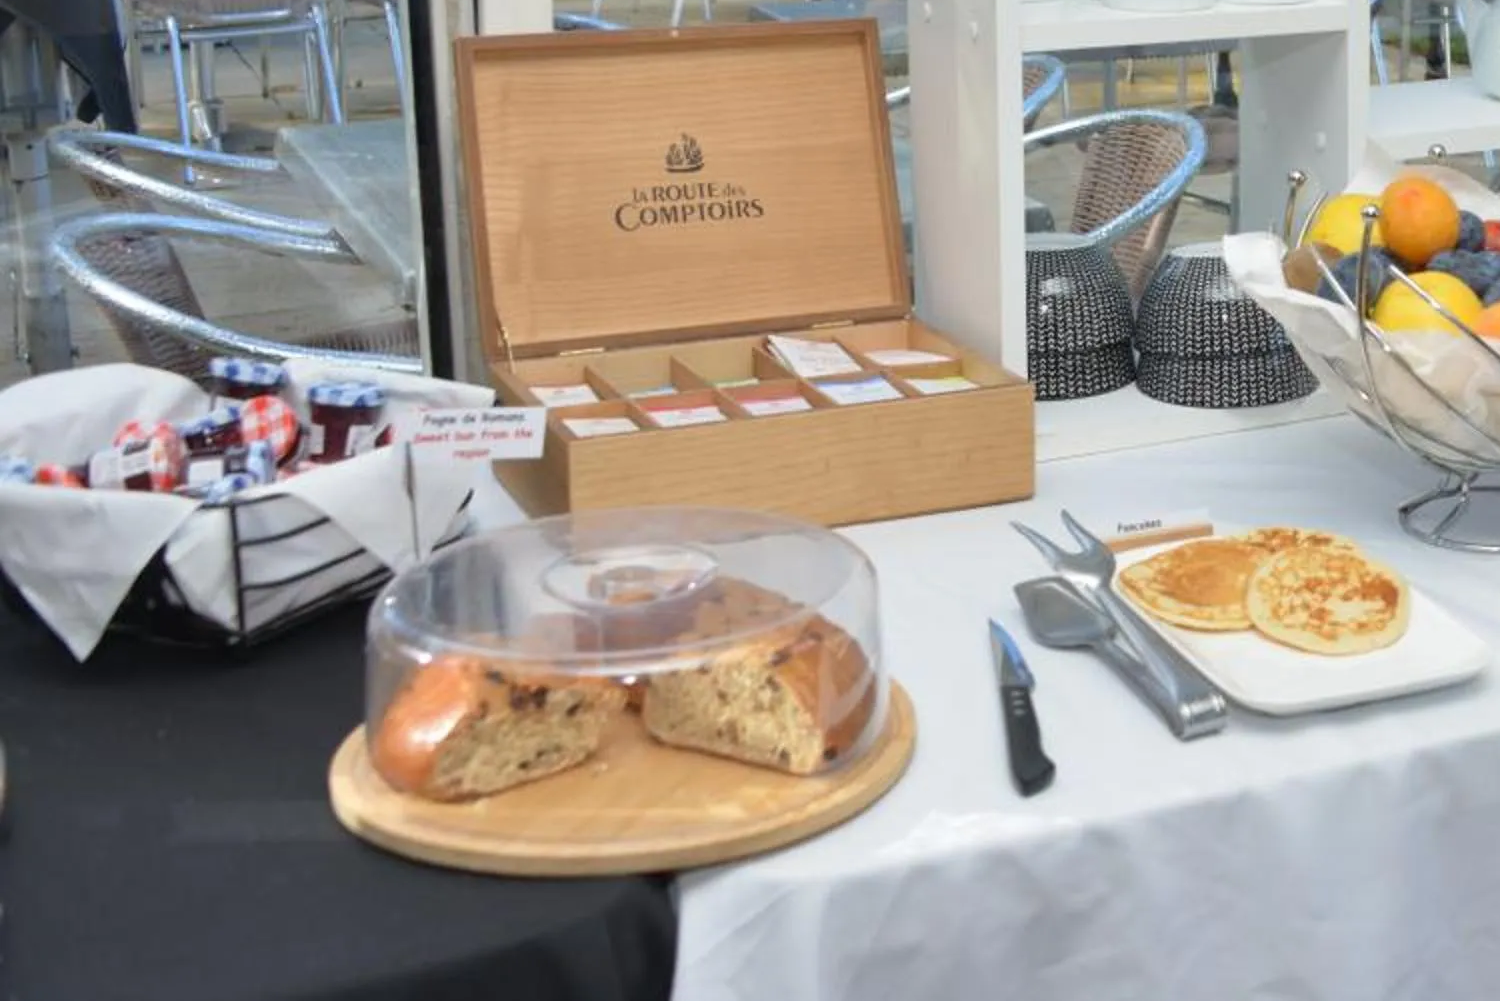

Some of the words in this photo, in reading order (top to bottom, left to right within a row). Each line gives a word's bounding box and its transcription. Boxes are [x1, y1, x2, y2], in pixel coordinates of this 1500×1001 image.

[652, 182, 719, 202] ROUTE
[722, 182, 747, 198] des
[514, 429, 533, 438] the
